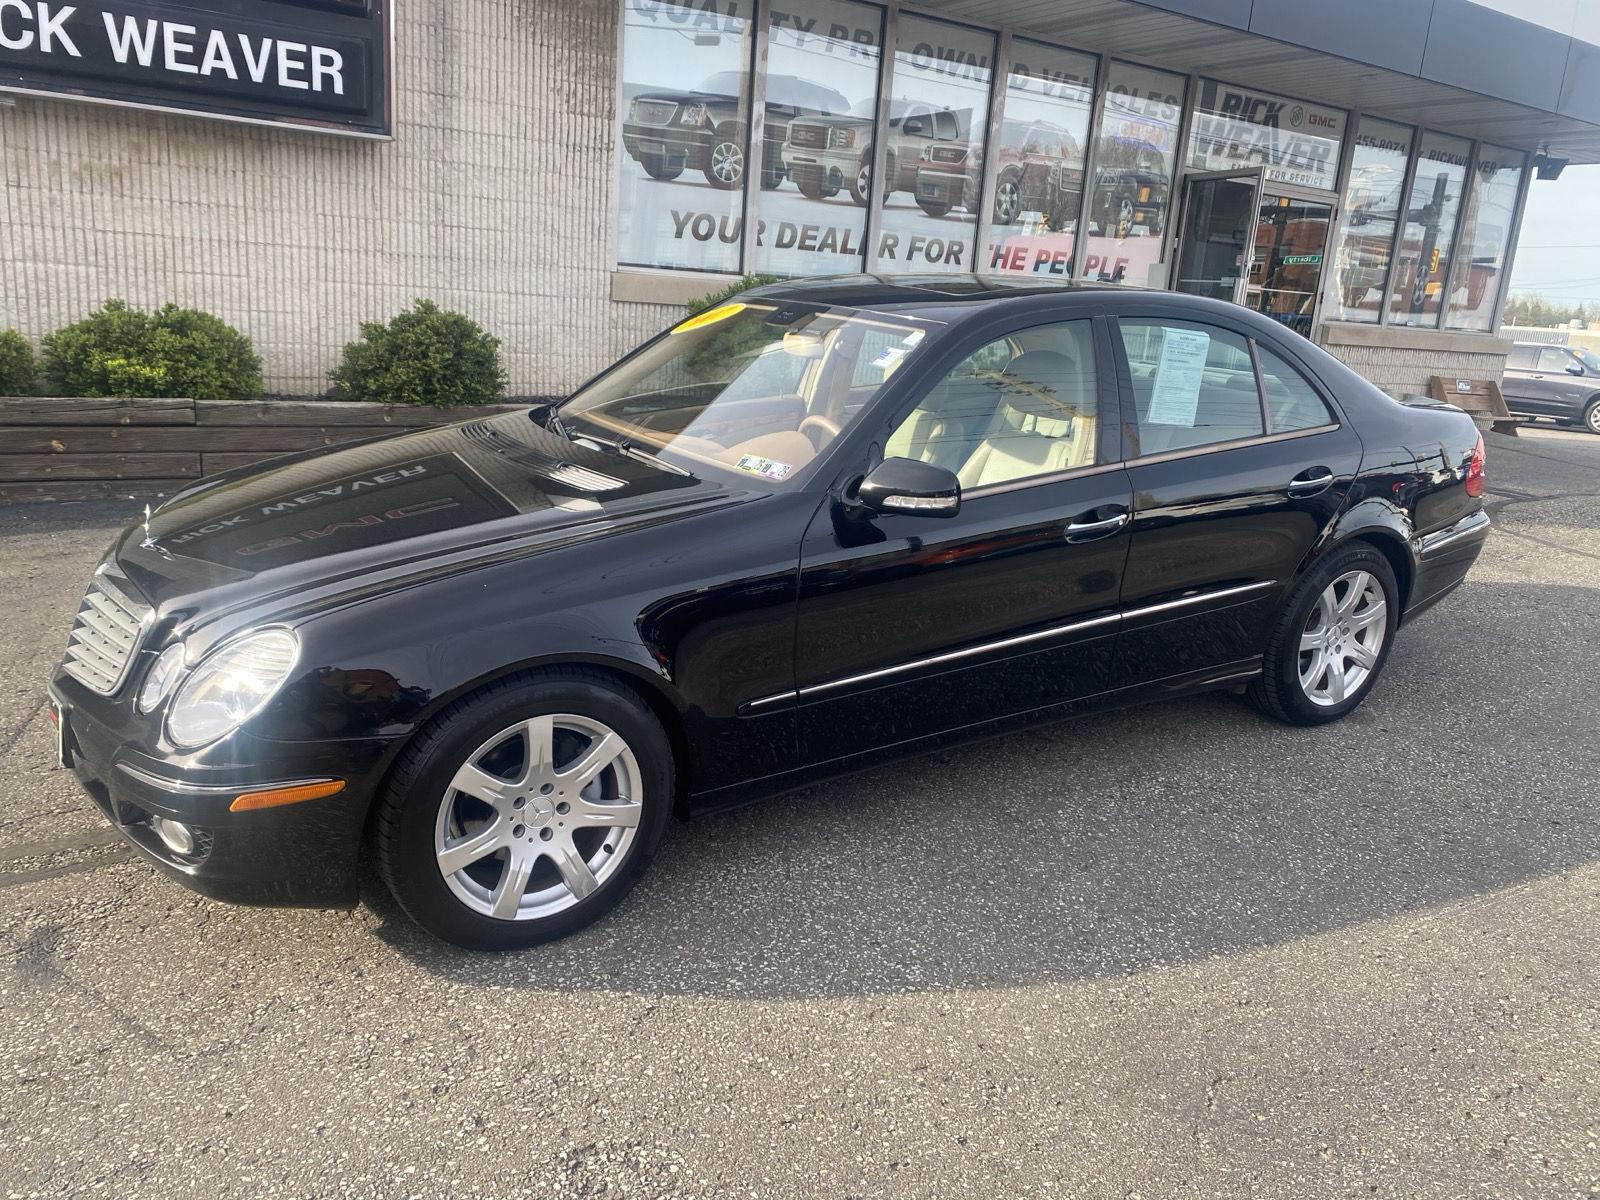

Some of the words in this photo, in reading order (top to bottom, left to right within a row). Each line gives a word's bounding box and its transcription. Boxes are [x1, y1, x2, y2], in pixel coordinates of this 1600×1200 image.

[101, 11, 344, 95] WEAVER
[633, 0, 816, 47] QUALTY
[1042, 68, 1178, 120] VECLES
[1218, 91, 1285, 128] RICK
[1308, 114, 1336, 128] GMC
[1196, 117, 1332, 173] WEAVER
[1269, 169, 1286, 179] FOR
[1289, 172, 1324, 186] SERVICE
[906, 235, 965, 266] FOR
[989, 244, 1029, 271] HE
[1033, 248, 1129, 280] PEPLE
